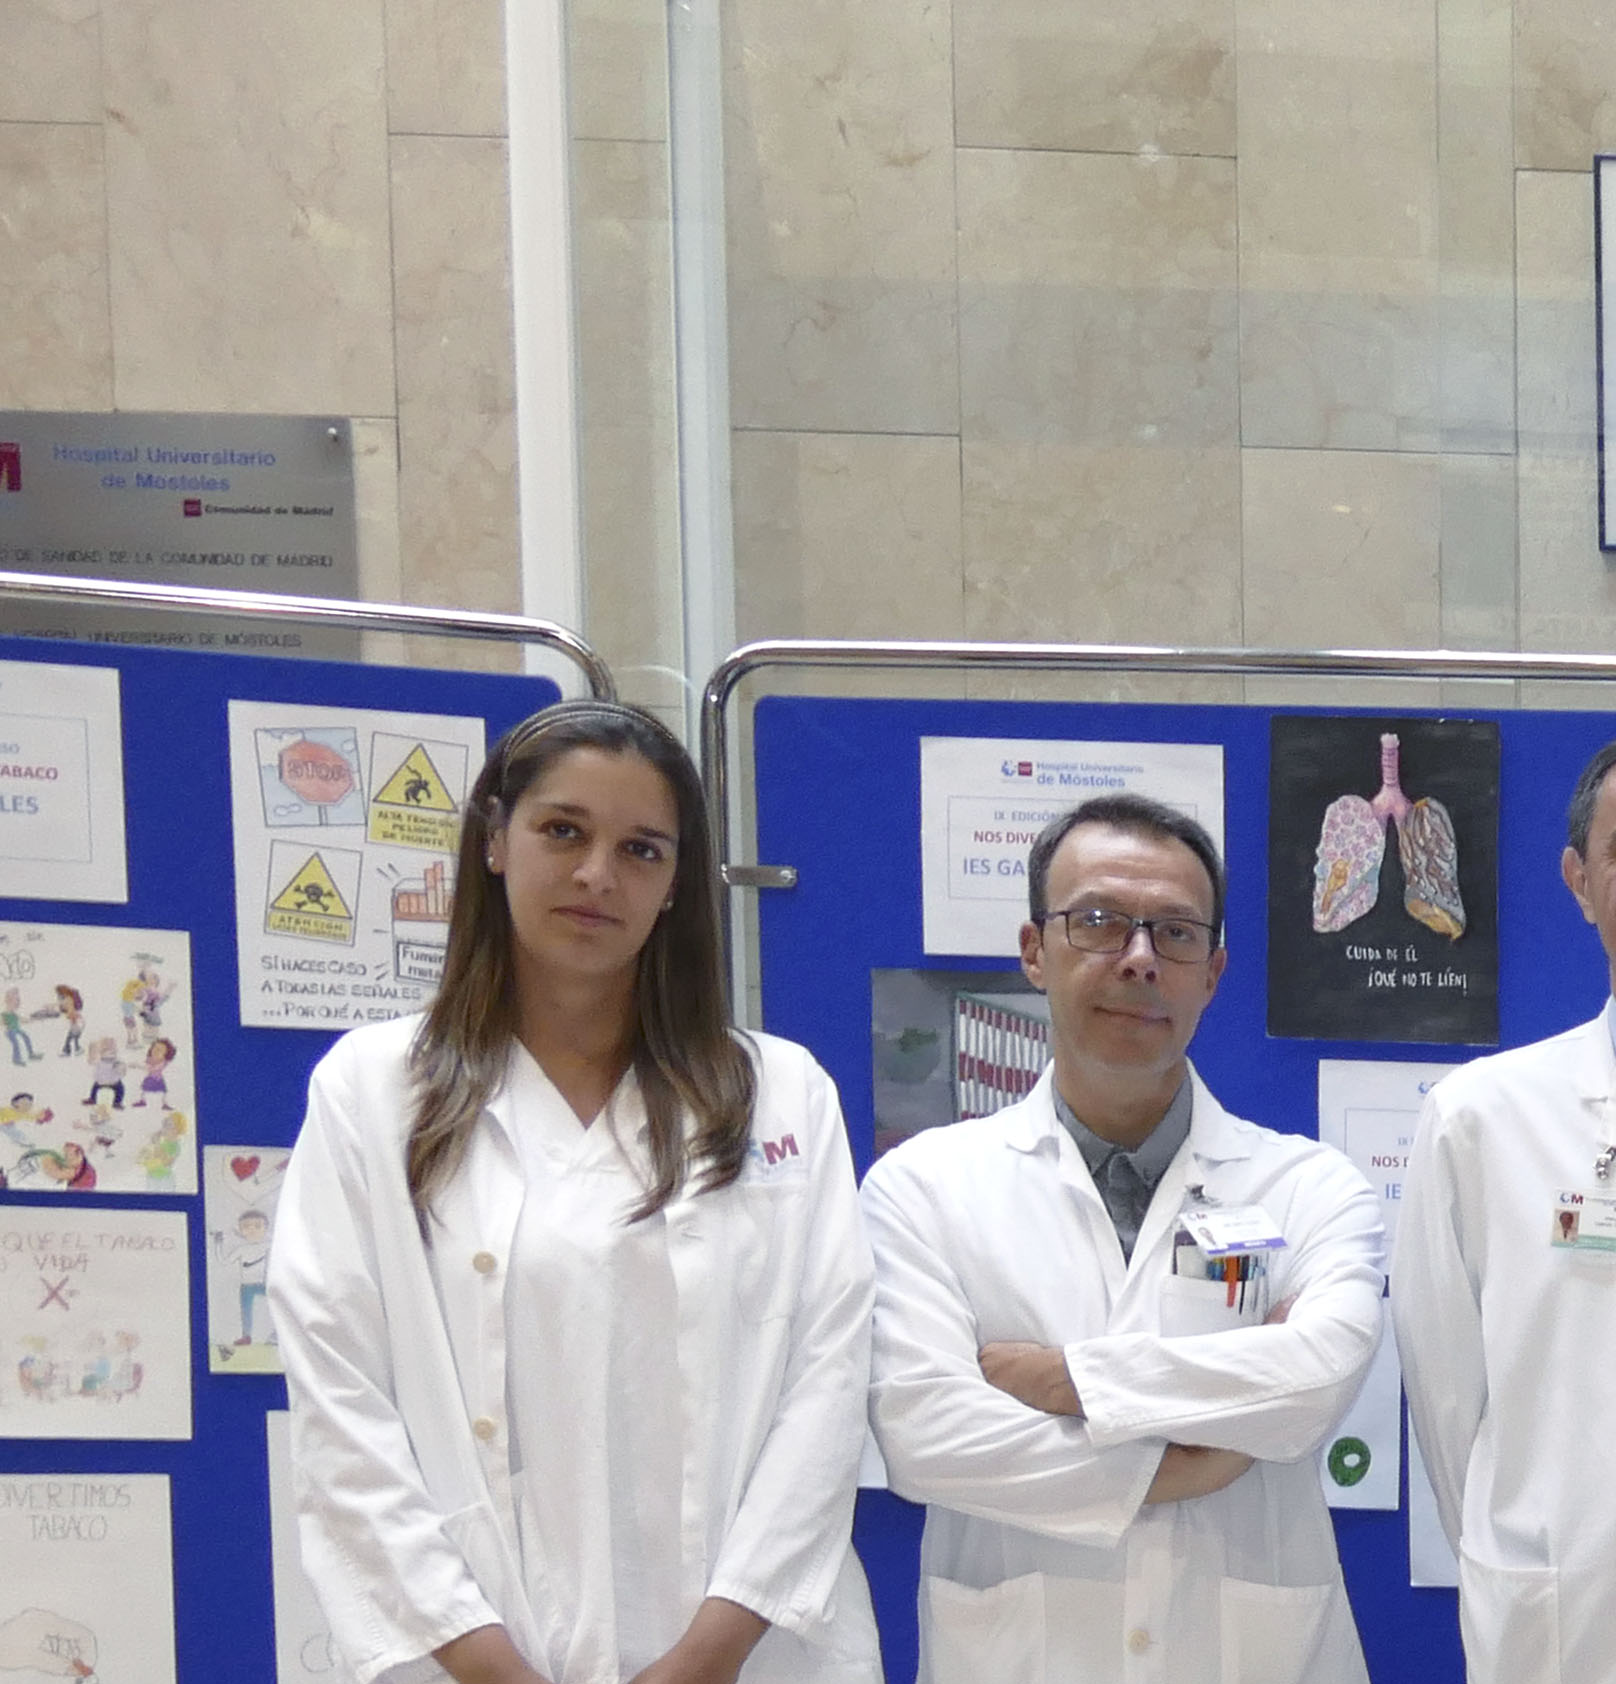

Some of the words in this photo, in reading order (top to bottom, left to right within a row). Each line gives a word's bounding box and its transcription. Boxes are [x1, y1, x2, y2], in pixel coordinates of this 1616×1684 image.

[53, 446, 138, 466] Hospital
[147, 446, 277, 467] Universitario
[100, 473, 127, 490] de
[1036, 773, 1054, 786] de
[973, 831, 1003, 844] NOS
[963, 858, 991, 876] IES
[1345, 944, 1382, 961] CUIDA
[1386, 947, 1399, 961] DE
[1402, 972, 1417, 988] NO
[1420, 971, 1432, 987] TE
[1371, 1155, 1400, 1168] NOS
